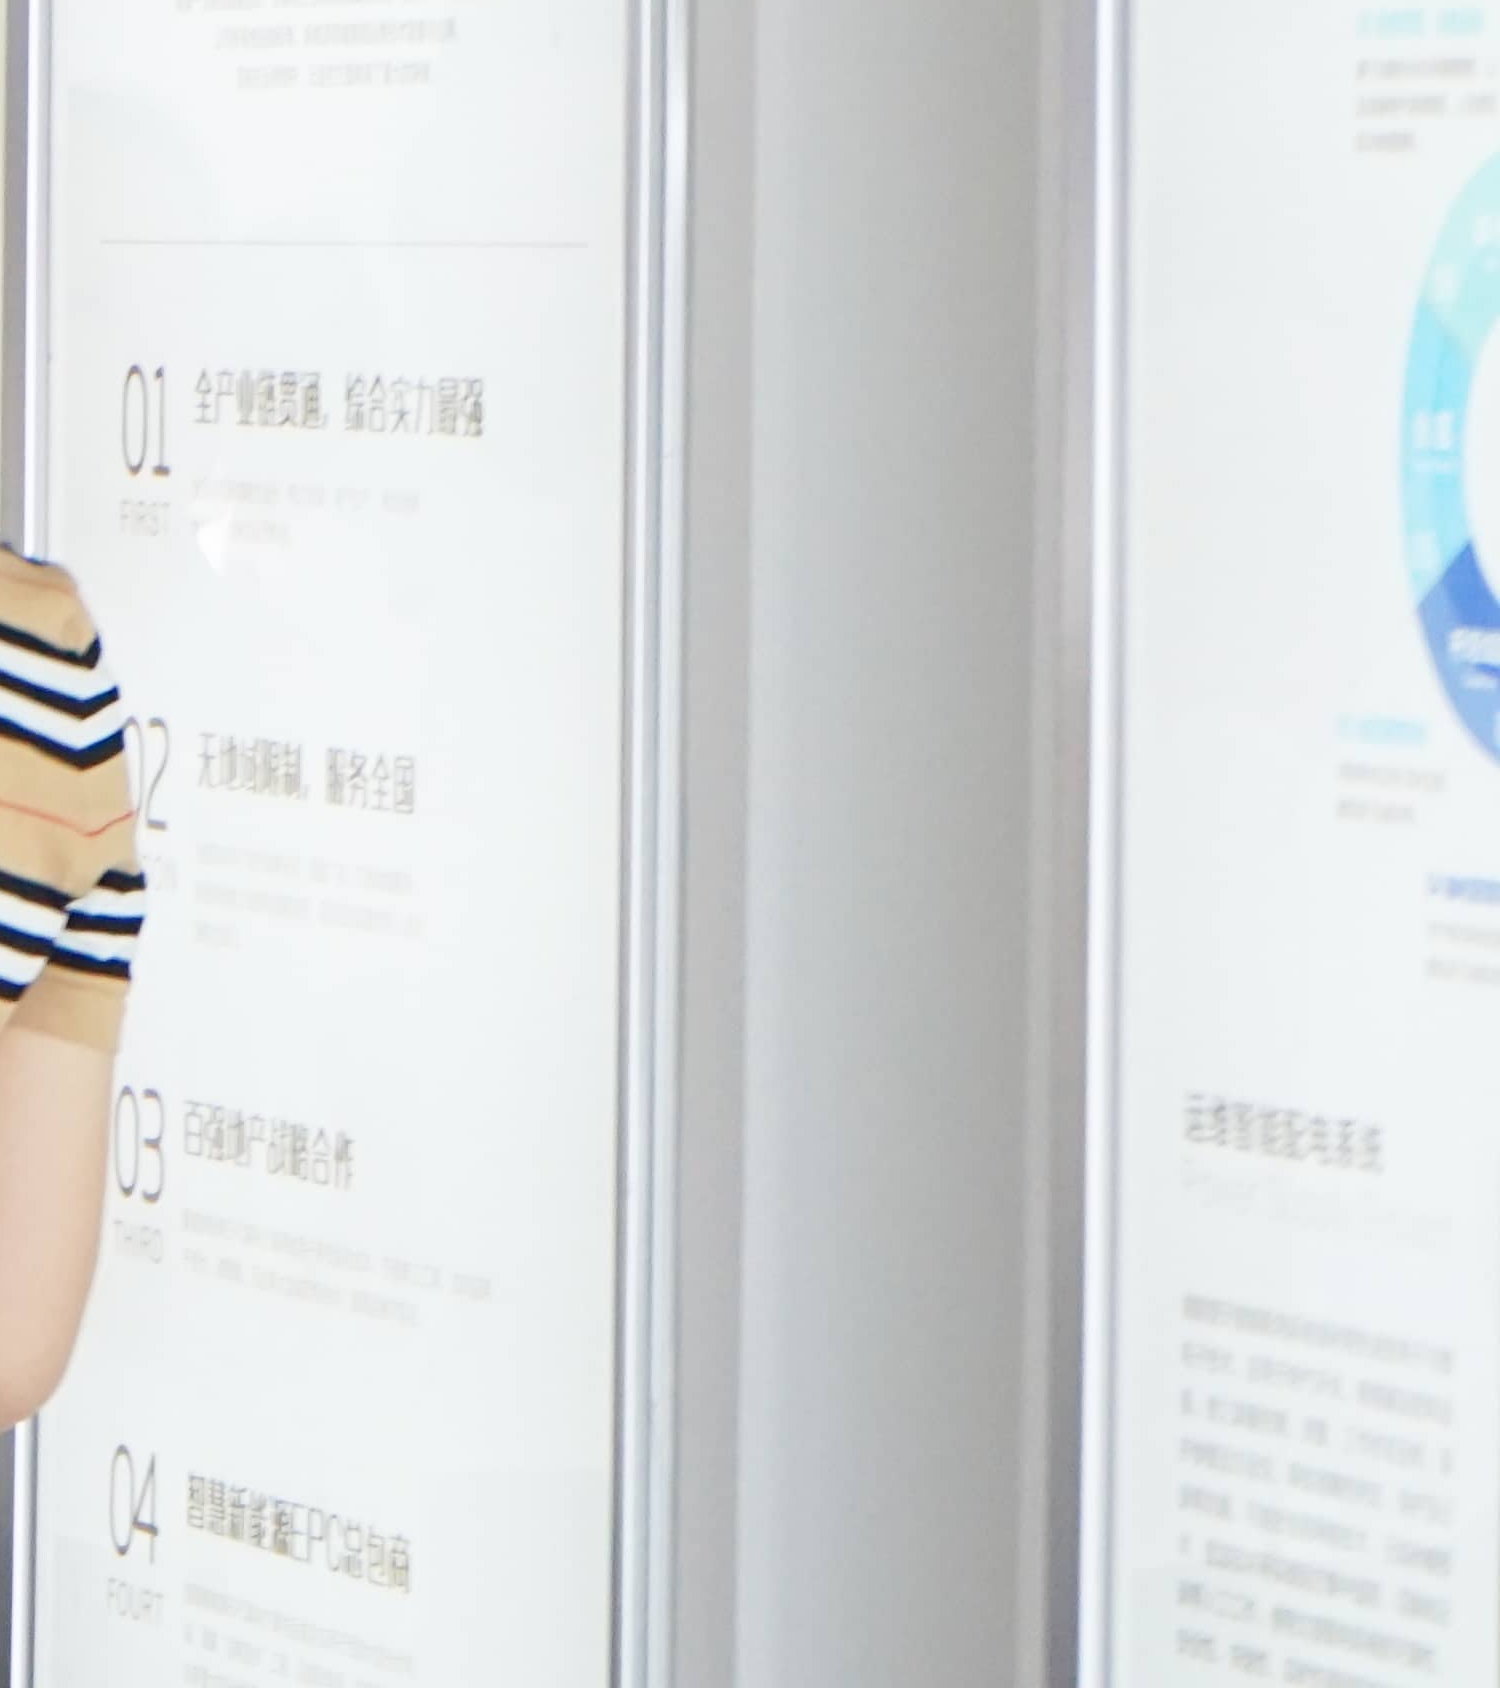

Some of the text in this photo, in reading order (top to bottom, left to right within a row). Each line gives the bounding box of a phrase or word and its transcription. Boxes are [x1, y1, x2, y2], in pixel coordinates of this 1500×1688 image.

[122, 363, 171, 477] 01
[114, 1085, 164, 1204] 03
[109, 1444, 159, 1565] 04
